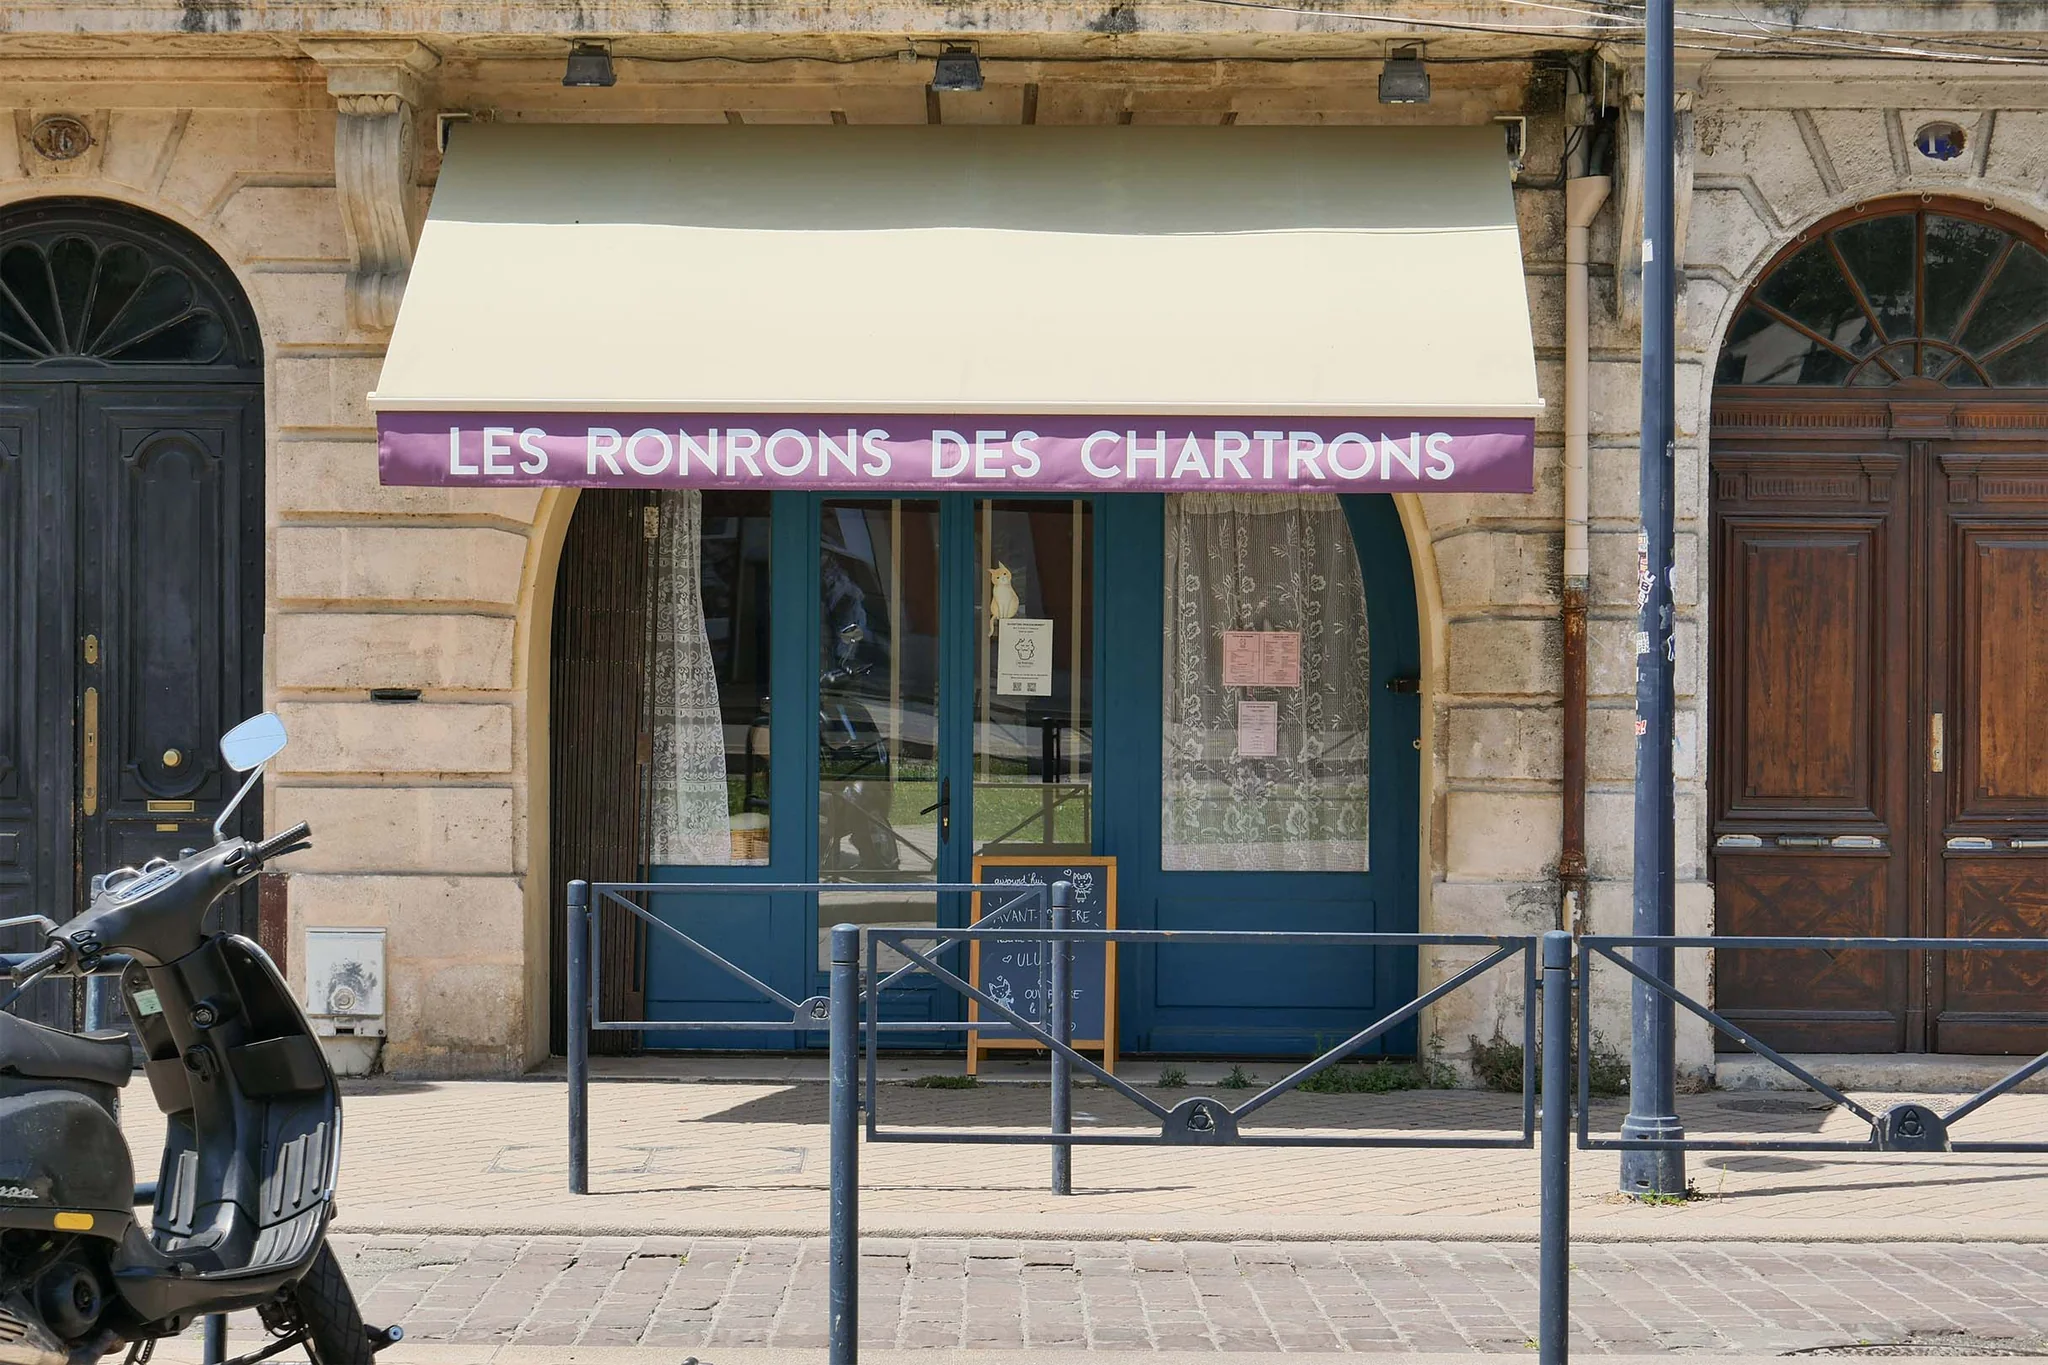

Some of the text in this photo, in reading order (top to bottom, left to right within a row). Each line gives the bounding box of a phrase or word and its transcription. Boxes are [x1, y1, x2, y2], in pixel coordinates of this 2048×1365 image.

[448, 426, 1456, 480] LES RONRONS DES CHARTRONS
